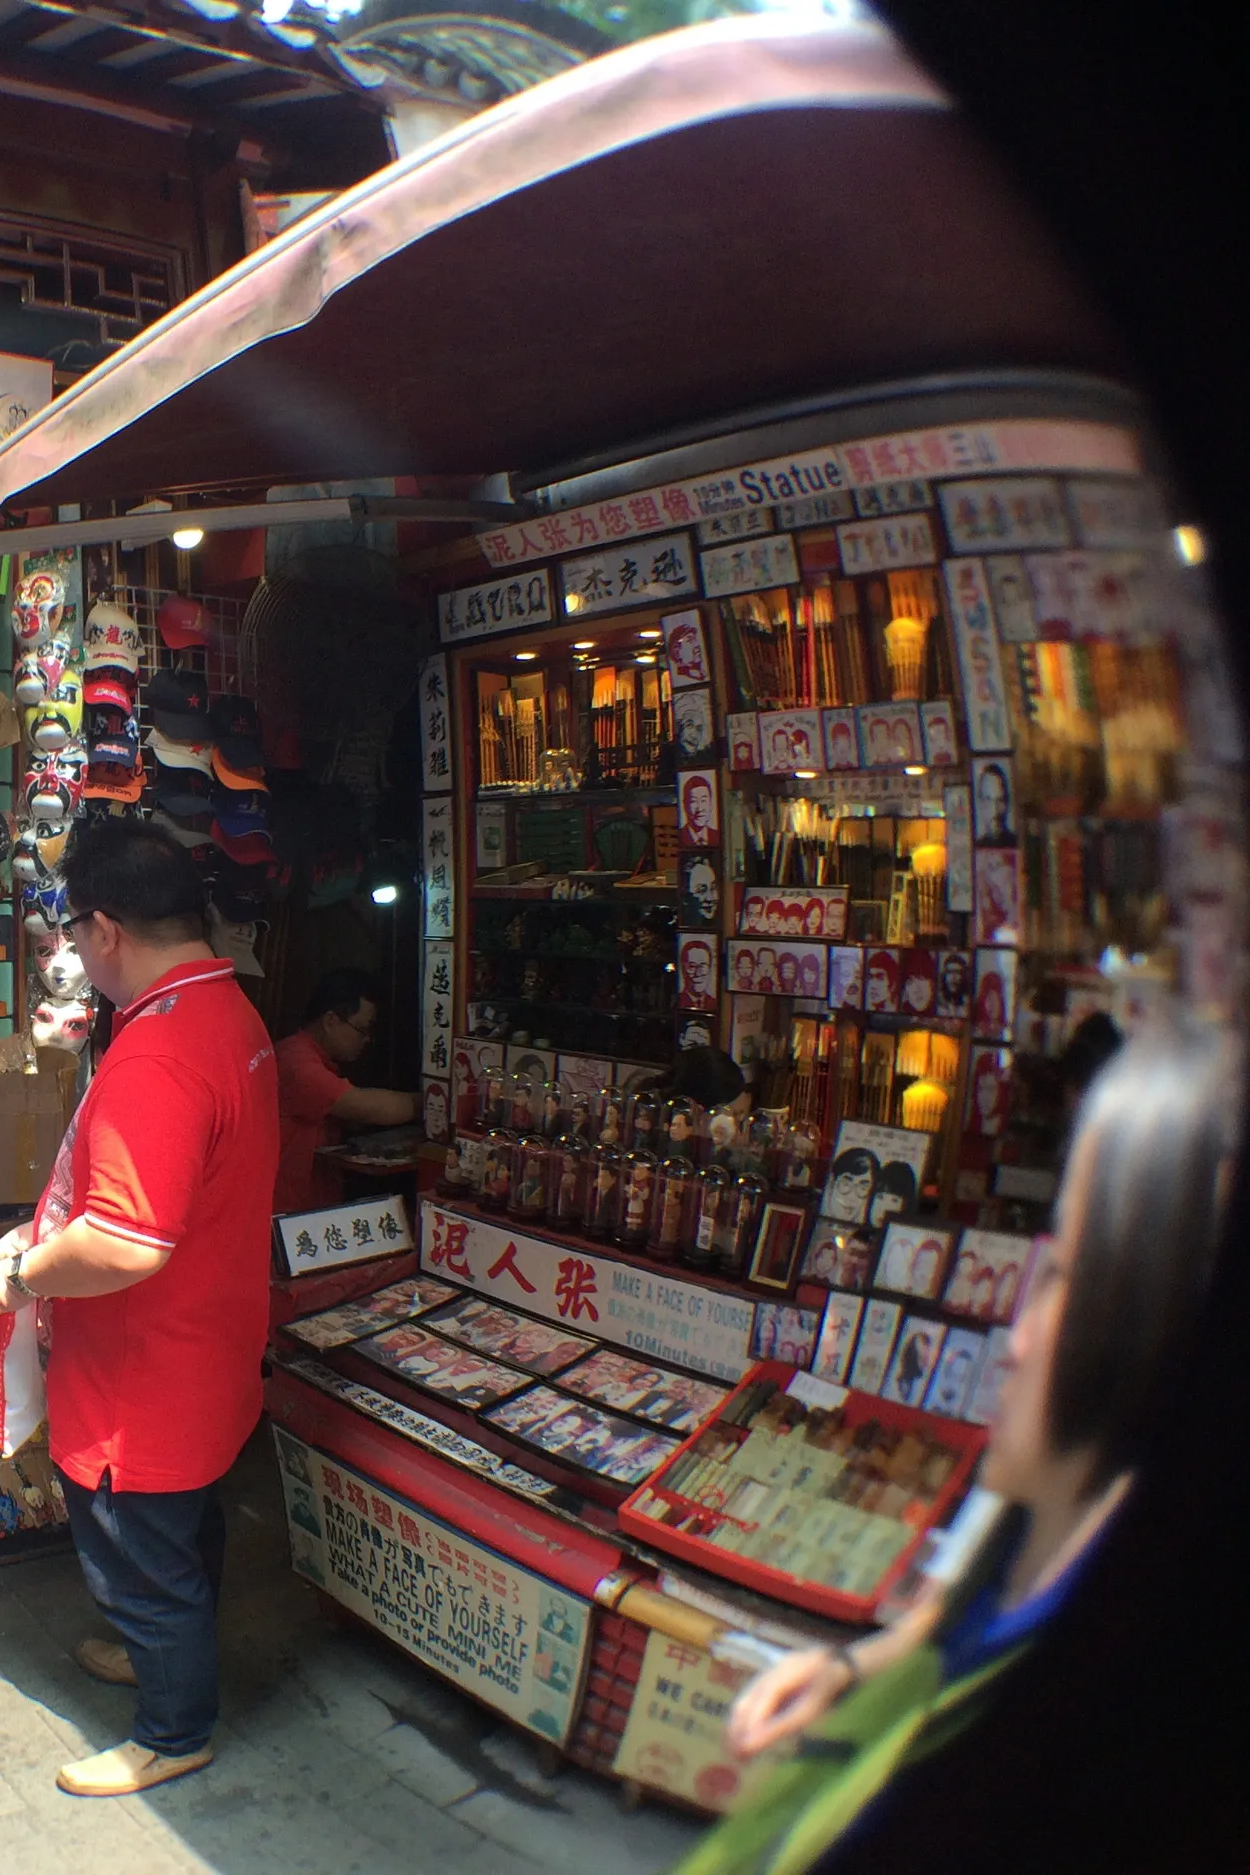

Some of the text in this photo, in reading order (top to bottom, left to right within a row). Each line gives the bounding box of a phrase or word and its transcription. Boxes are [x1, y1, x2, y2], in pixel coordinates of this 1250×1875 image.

[485, 487, 698, 563] 泥人张为您塑像
[740, 460, 843, 505] Statue
[430, 1211, 601, 1323] 泥人张
[612, 1270, 641, 1299] MAKE
[656, 1286, 684, 1313] FACE
[687, 1295, 704, 1317] OF
[325, 1518, 363, 1561] MAKE
[369, 1552, 378, 1573] A
[384, 1557, 418, 1599] FACE
[424, 1583, 443, 1613] OF
[450, 1600, 529, 1663] YOURSELF
[328, 1557, 359, 1589] Take
[371, 1591, 407, 1623] photo
[410, 1619, 424, 1633] or
[427, 1630, 477, 1667] provide
[479, 1661, 519, 1694] photo
[329, 1545, 522, 1681] WHAT A CUTE MINI ME
[413, 1635, 461, 1673] Minutes
